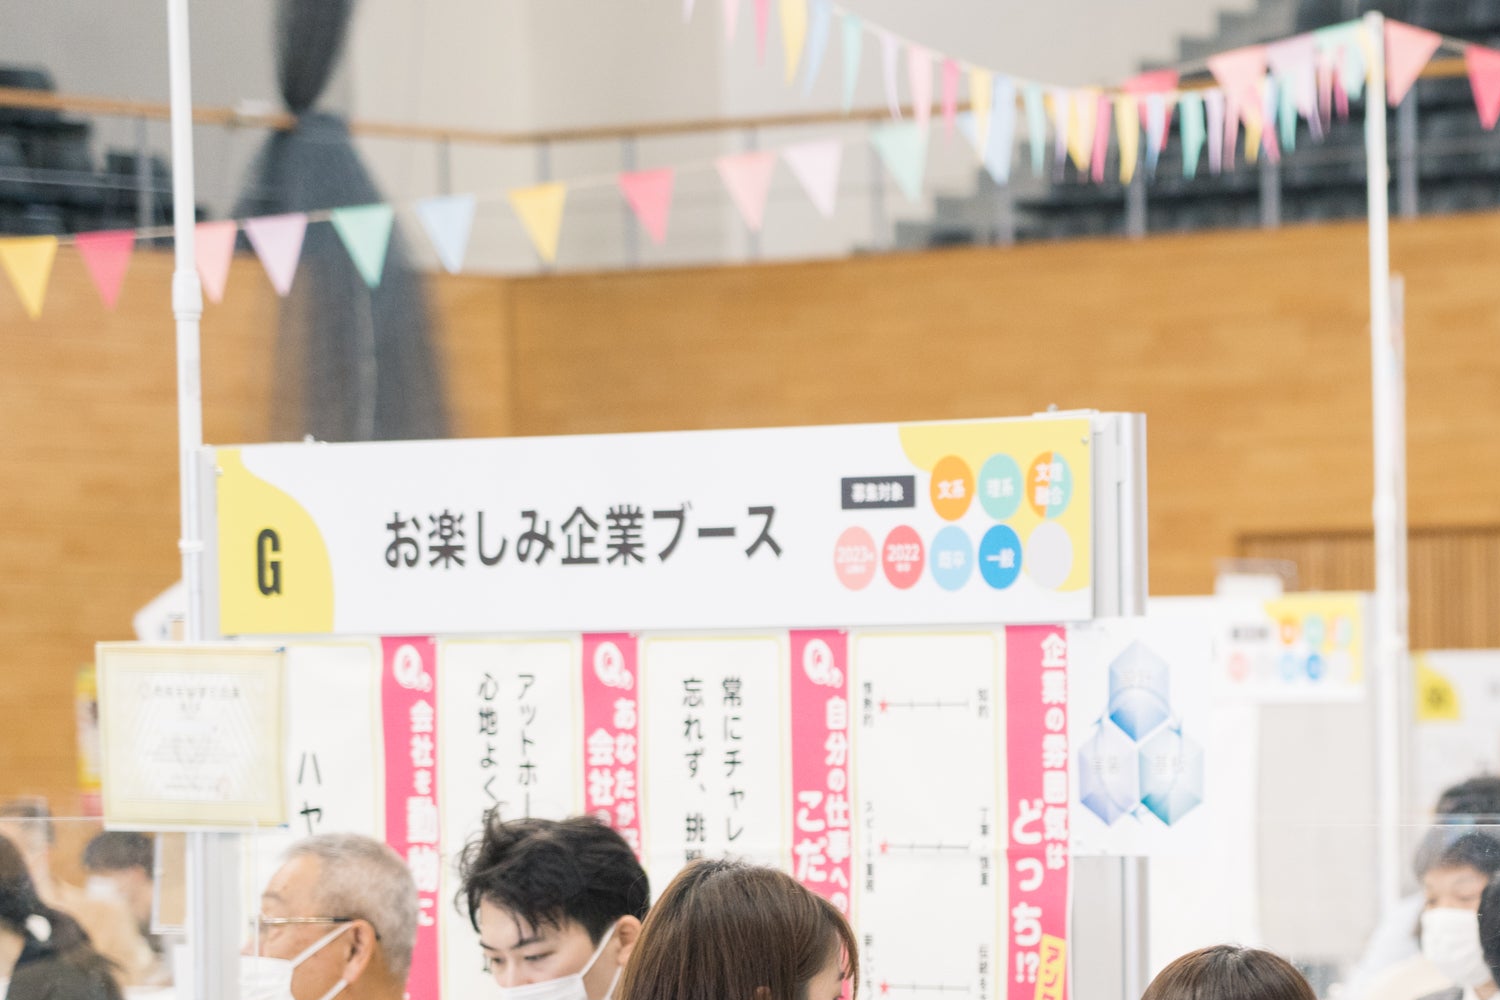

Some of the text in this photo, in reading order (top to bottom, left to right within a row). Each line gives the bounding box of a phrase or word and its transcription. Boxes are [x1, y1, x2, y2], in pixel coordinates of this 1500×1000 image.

[256, 528, 283, 597] G
[384, 503, 784, 571] お楽しみ企業ブース
[478, 672, 500, 822] 心地よく
[722, 677, 745, 857] 常にチャレ
